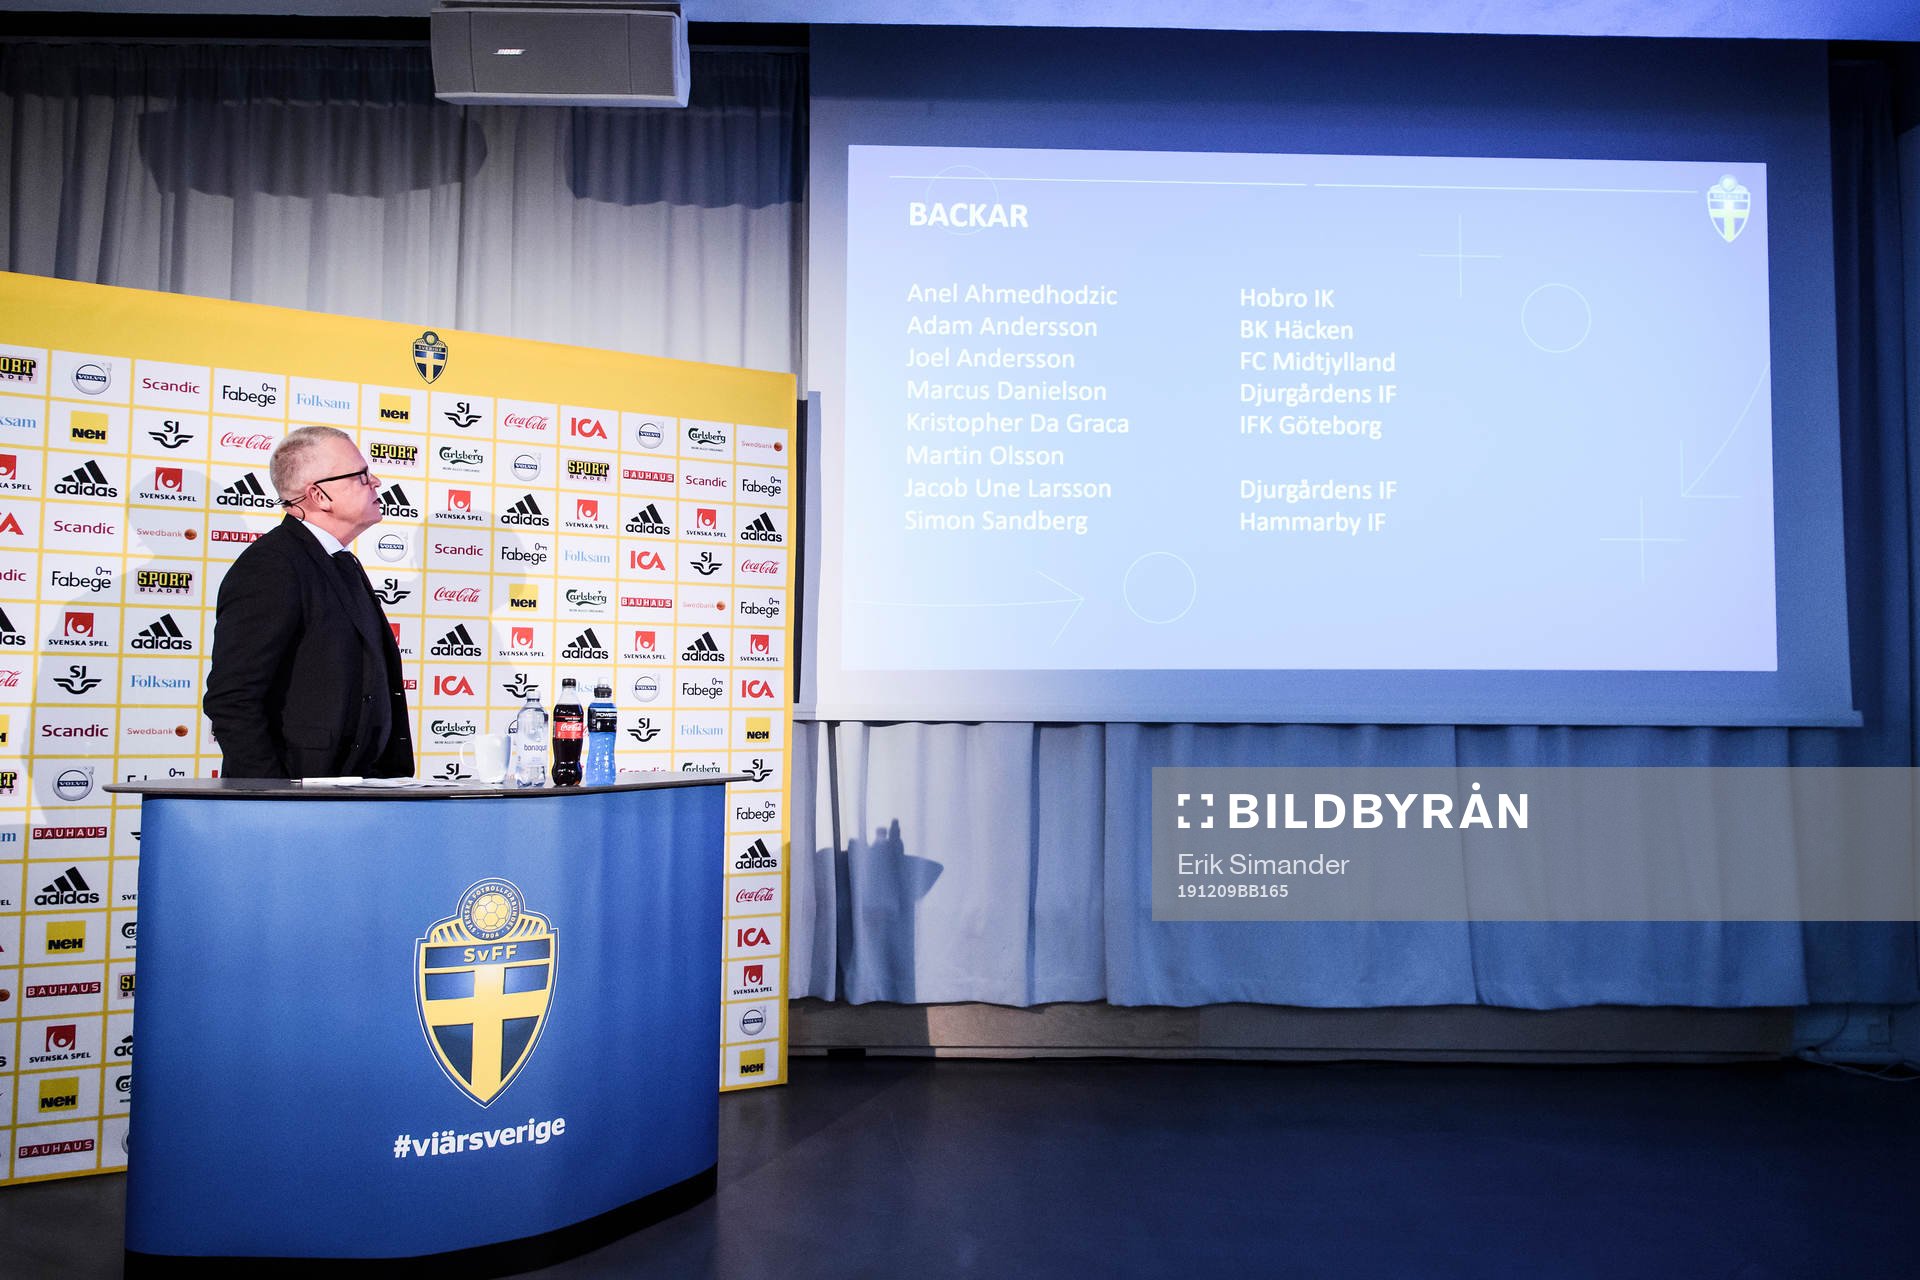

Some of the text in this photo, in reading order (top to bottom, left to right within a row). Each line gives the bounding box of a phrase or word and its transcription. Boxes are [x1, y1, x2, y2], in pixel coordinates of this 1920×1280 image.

[909, 202, 1029, 228] BACKAR
[907, 284, 1118, 305] Anel Ahmedhodzic
[1241, 288, 1335, 308] Hobro IK
[907, 315, 1097, 337] Adam Andersson
[1241, 320, 1353, 340] BK Häcken
[906, 347, 1075, 368] Joel Andersson
[1241, 352, 1396, 376] FC Midtjylland
[0, 356, 36, 376] ORT
[77, 374, 106, 382] VOLVO
[142, 378, 200, 394] Scandic
[222, 385, 276, 407] Fabege
[907, 380, 1107, 401] Marcus Danielson
[1241, 383, 1396, 407] Djurgårdens IF
[296, 393, 350, 410] Folksam
[457, 402, 470, 415] SJ
[164, 421, 180, 433] SJ
[571, 417, 607, 439] ICA
[907, 412, 1128, 436] Kristopher Da Graca
[1241, 415, 1382, 440] IFK Göteborg
[688, 427, 726, 444] Carlsberg
[370, 443, 418, 460] SPORT
[439, 447, 483, 464] Carlsberg
[906, 445, 1064, 465] Martin Olsson
[372, 457, 415, 465] BLADET
[567, 461, 610, 477] SPORT
[569, 474, 607, 482] BLADET
[624, 471, 673, 482] BAUHAUS
[686, 476, 727, 488] Scandic
[12, 482, 32, 490] SPEL
[55, 482, 118, 498] adidas
[742, 479, 781, 497] Fabege
[904, 478, 1112, 498] Jacob Une Larsson
[1241, 479, 1397, 503] Djurgårdens IF
[140, 492, 197, 502] SVENSKA SPEL
[216, 494, 275, 508] adidas
[381, 504, 418, 518] didas
[435, 512, 466, 520] SVENSKA
[53, 520, 115, 535] Scandic
[501, 514, 549, 526] adidas
[565, 521, 593, 529] SVENSKA
[904, 510, 1088, 535] Simon Sandberg
[1241, 512, 1386, 536] Hammarby IF
[136, 528, 182, 538] Swedbank
[212, 531, 261, 543] BAUHA
[625, 523, 670, 535] adidas
[740, 530, 782, 542] adidas
[435, 543, 484, 557] Scandic
[502, 546, 547, 565] Fabege
[564, 550, 610, 564] Folksam
[701, 552, 712, 564] SJ
[630, 551, 666, 571] ICA
[51, 571, 111, 592] Fabege
[137, 571, 192, 588] SPORT
[384, 579, 398, 591] SJ
[566, 589, 607, 606] Carlsberg
[621, 597, 672, 607] BAUHAUS
[740, 601, 780, 618] Fabege
[48, 639, 86, 647] SVENSKA
[131, 637, 192, 650] adidas
[430, 645, 482, 657] adidas
[562, 648, 609, 660] adidas
[682, 651, 725, 662] adidas
[69, 665, 86, 678] SJ
[515, 674, 527, 685] SJ
[131, 674, 190, 689] Folksam
[434, 675, 474, 696] ICA
[742, 680, 774, 698] ICA
[682, 682, 723, 699] Fabege
[42, 725, 109, 737] Scandic
[431, 720, 476, 738] Carlsberg
[638, 718, 651, 729] SJ
[681, 724, 723, 736] Folksam
[446, 763, 460, 776] SJ
[752, 759, 763, 769] SJ
[736, 807, 775, 823] Fabege
[34, 828, 106, 838] BAUHAUS
[735, 857, 777, 870] adidas
[34, 890, 99, 906] adidas
[737, 928, 770, 947] ICA
[464, 945, 518, 962] SvFF
[28, 984, 99, 996] BAUHAUS
[29, 1054, 68, 1063] SVENSKA
[393, 1117, 566, 1158] #viärsverige
[19, 1139, 94, 1158] BAUHAUS
